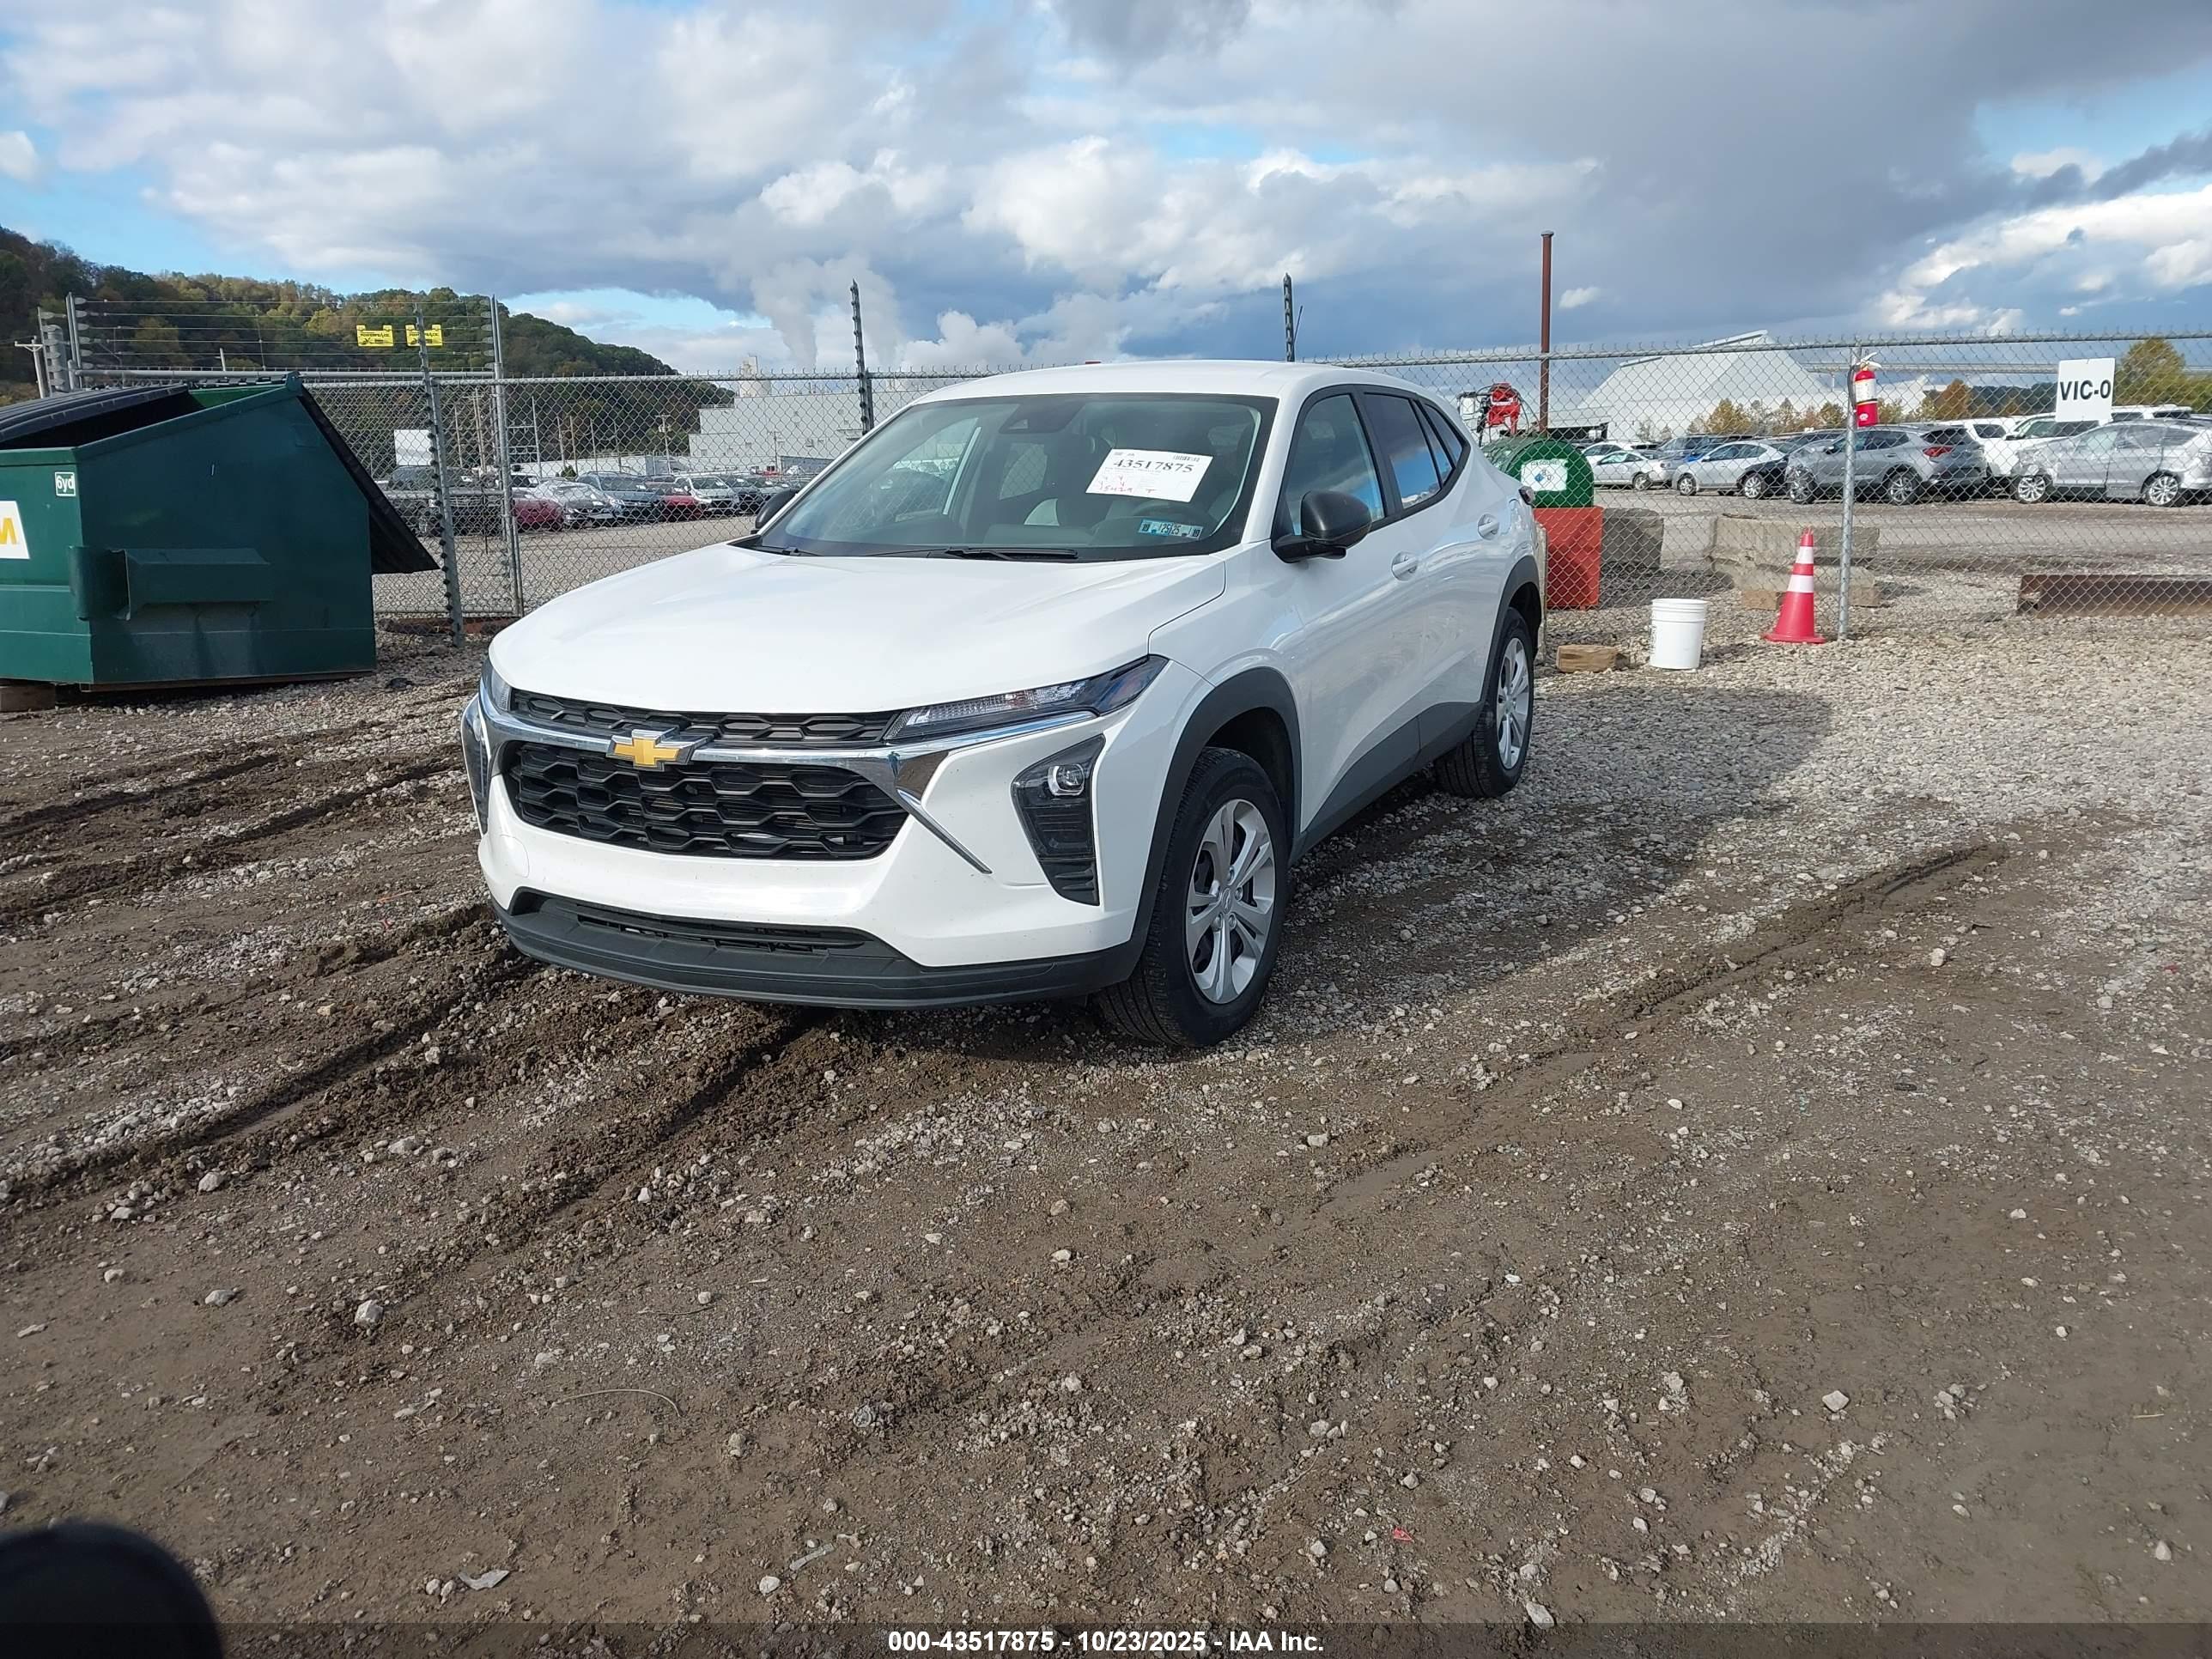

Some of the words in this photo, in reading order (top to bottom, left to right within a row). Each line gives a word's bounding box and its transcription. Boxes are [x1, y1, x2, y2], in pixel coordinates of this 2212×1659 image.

[1114, 459, 1195, 473] 43517875
[57, 475, 75, 493] 6yd
[1170, 525, 1182, 535] 25
